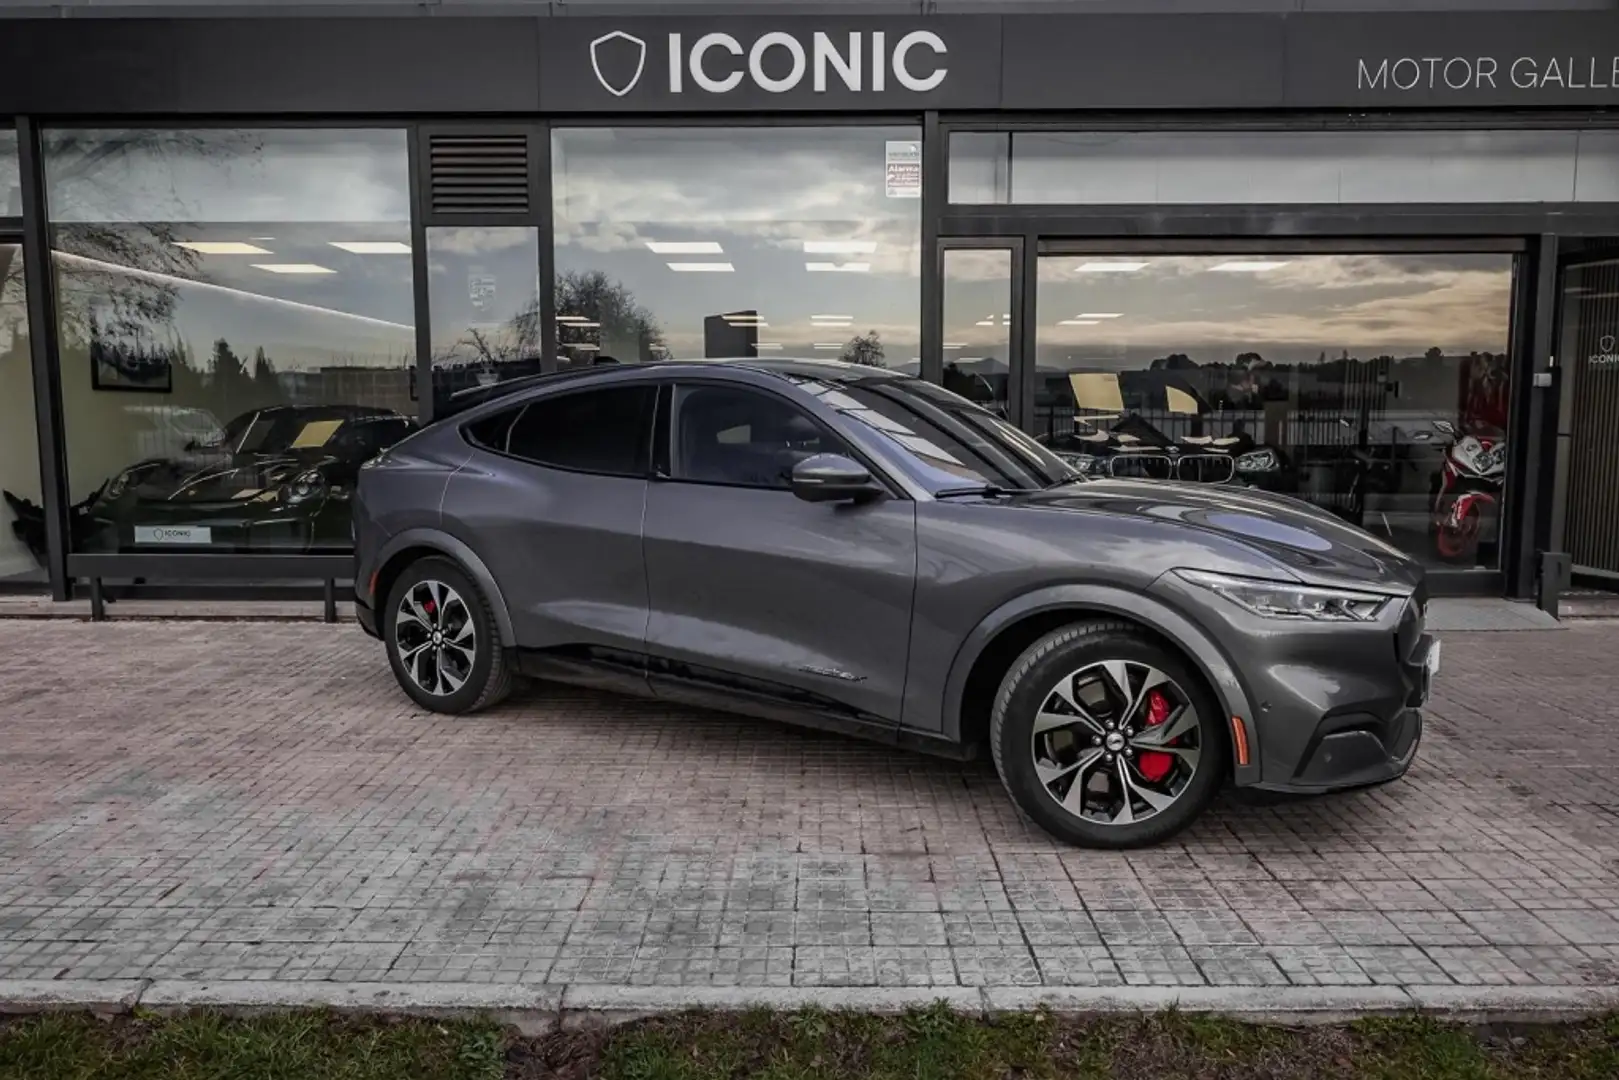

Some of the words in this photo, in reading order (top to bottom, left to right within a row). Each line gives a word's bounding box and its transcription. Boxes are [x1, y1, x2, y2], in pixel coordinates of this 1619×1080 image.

[668, 30, 949, 93] ICONIC
[1357, 56, 1498, 90] MOTOR
[1588, 354, 1619, 364] ICONI
